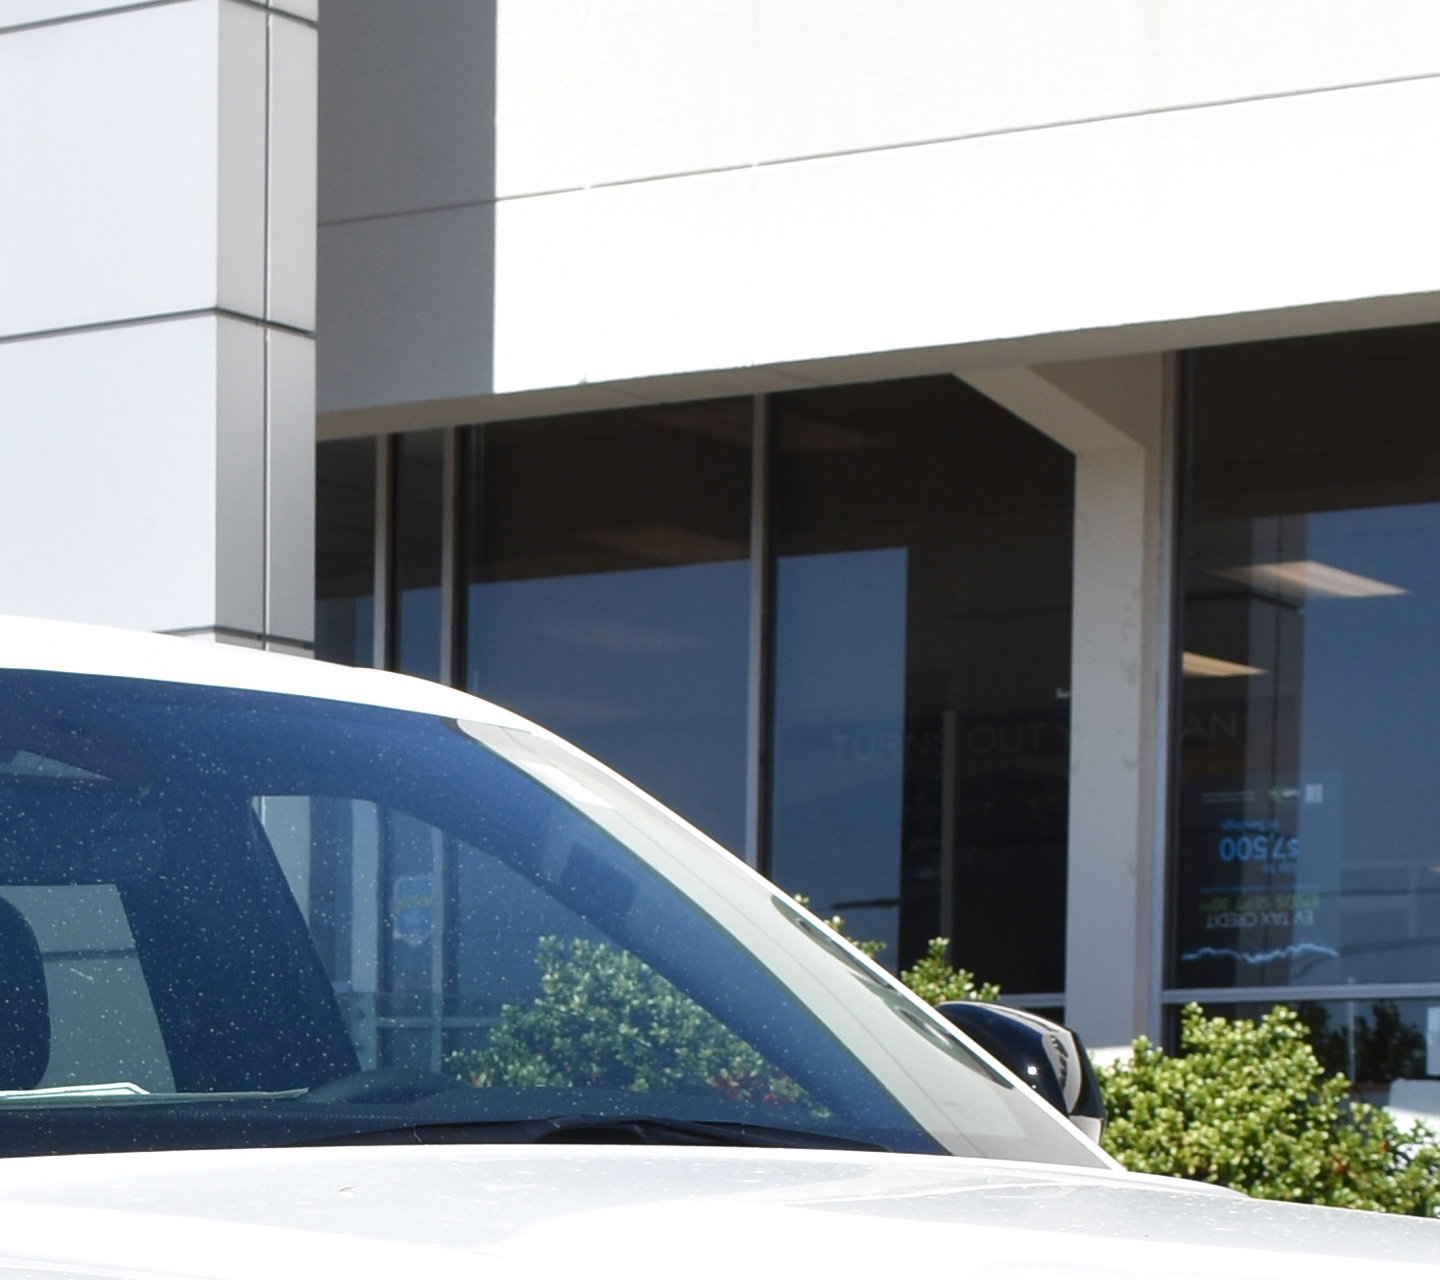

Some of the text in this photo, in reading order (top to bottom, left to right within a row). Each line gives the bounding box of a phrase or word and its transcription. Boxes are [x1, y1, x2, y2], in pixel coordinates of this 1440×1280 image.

[1182, 711, 1237, 738] AN
[1206, 911, 1261, 928] CREDIT
[1263, 911, 1291, 927] TAX
